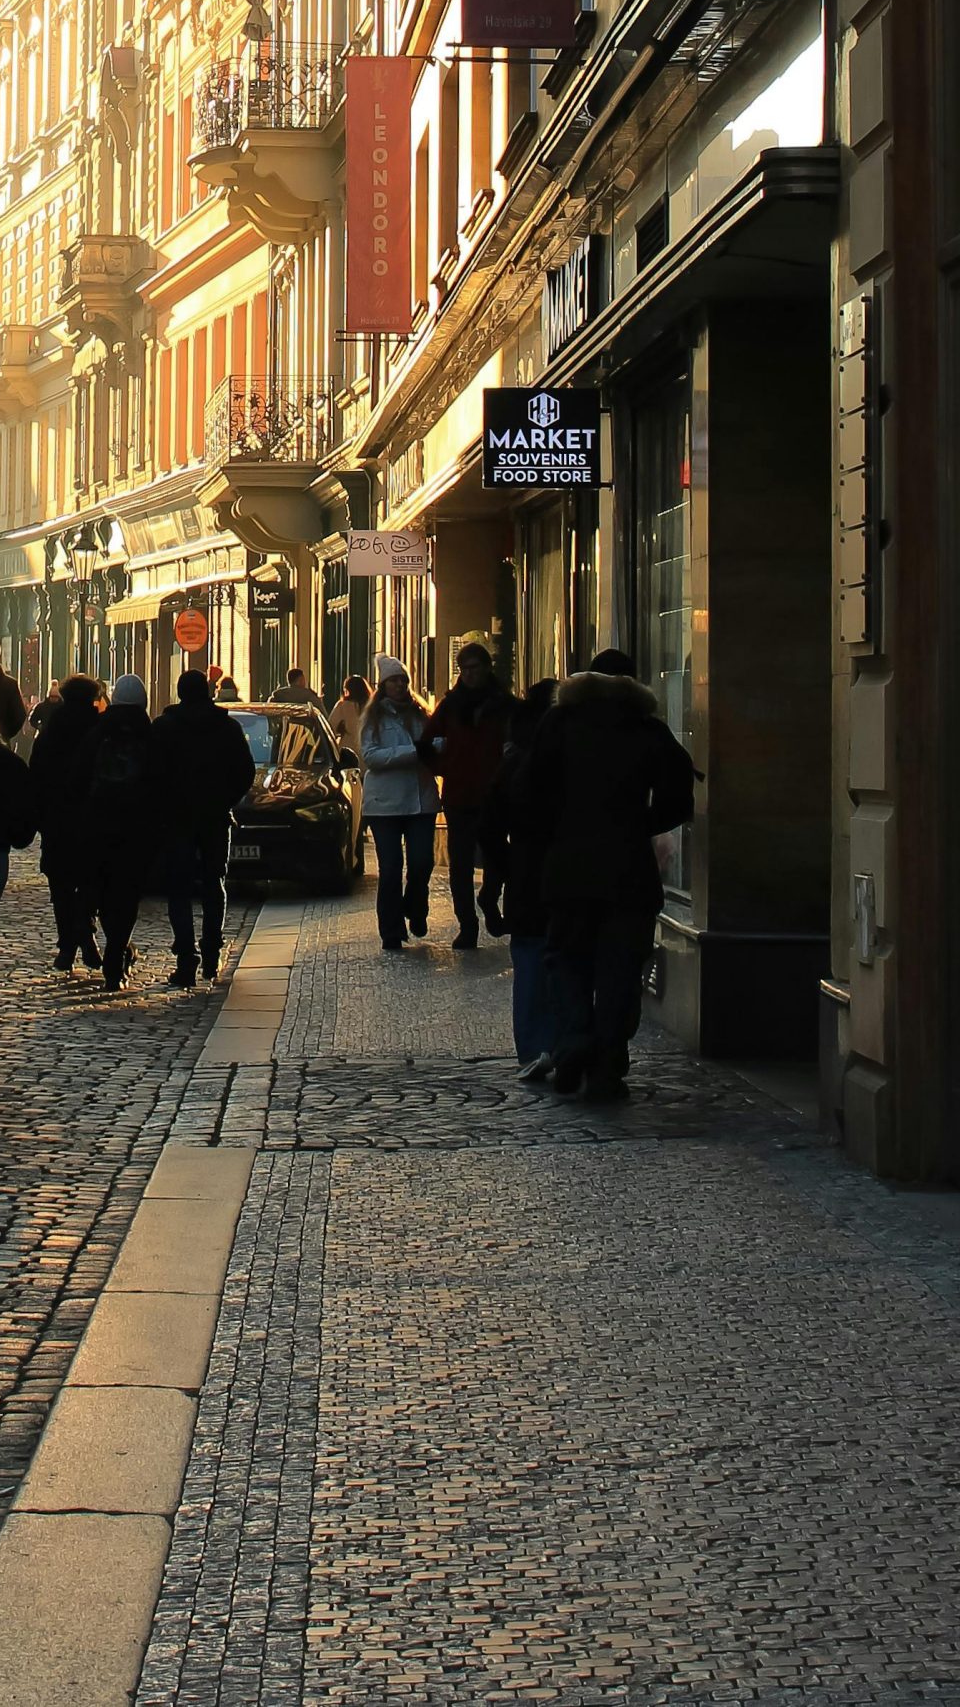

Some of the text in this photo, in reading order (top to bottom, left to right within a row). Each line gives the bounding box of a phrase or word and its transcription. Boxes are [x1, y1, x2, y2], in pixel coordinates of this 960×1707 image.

[489, 429, 596, 449] MARKET
[498, 453, 586, 465] SOUVENIRS
[493, 470, 591, 483] FOOD STORE
[391, 555, 423, 563] SISTER
